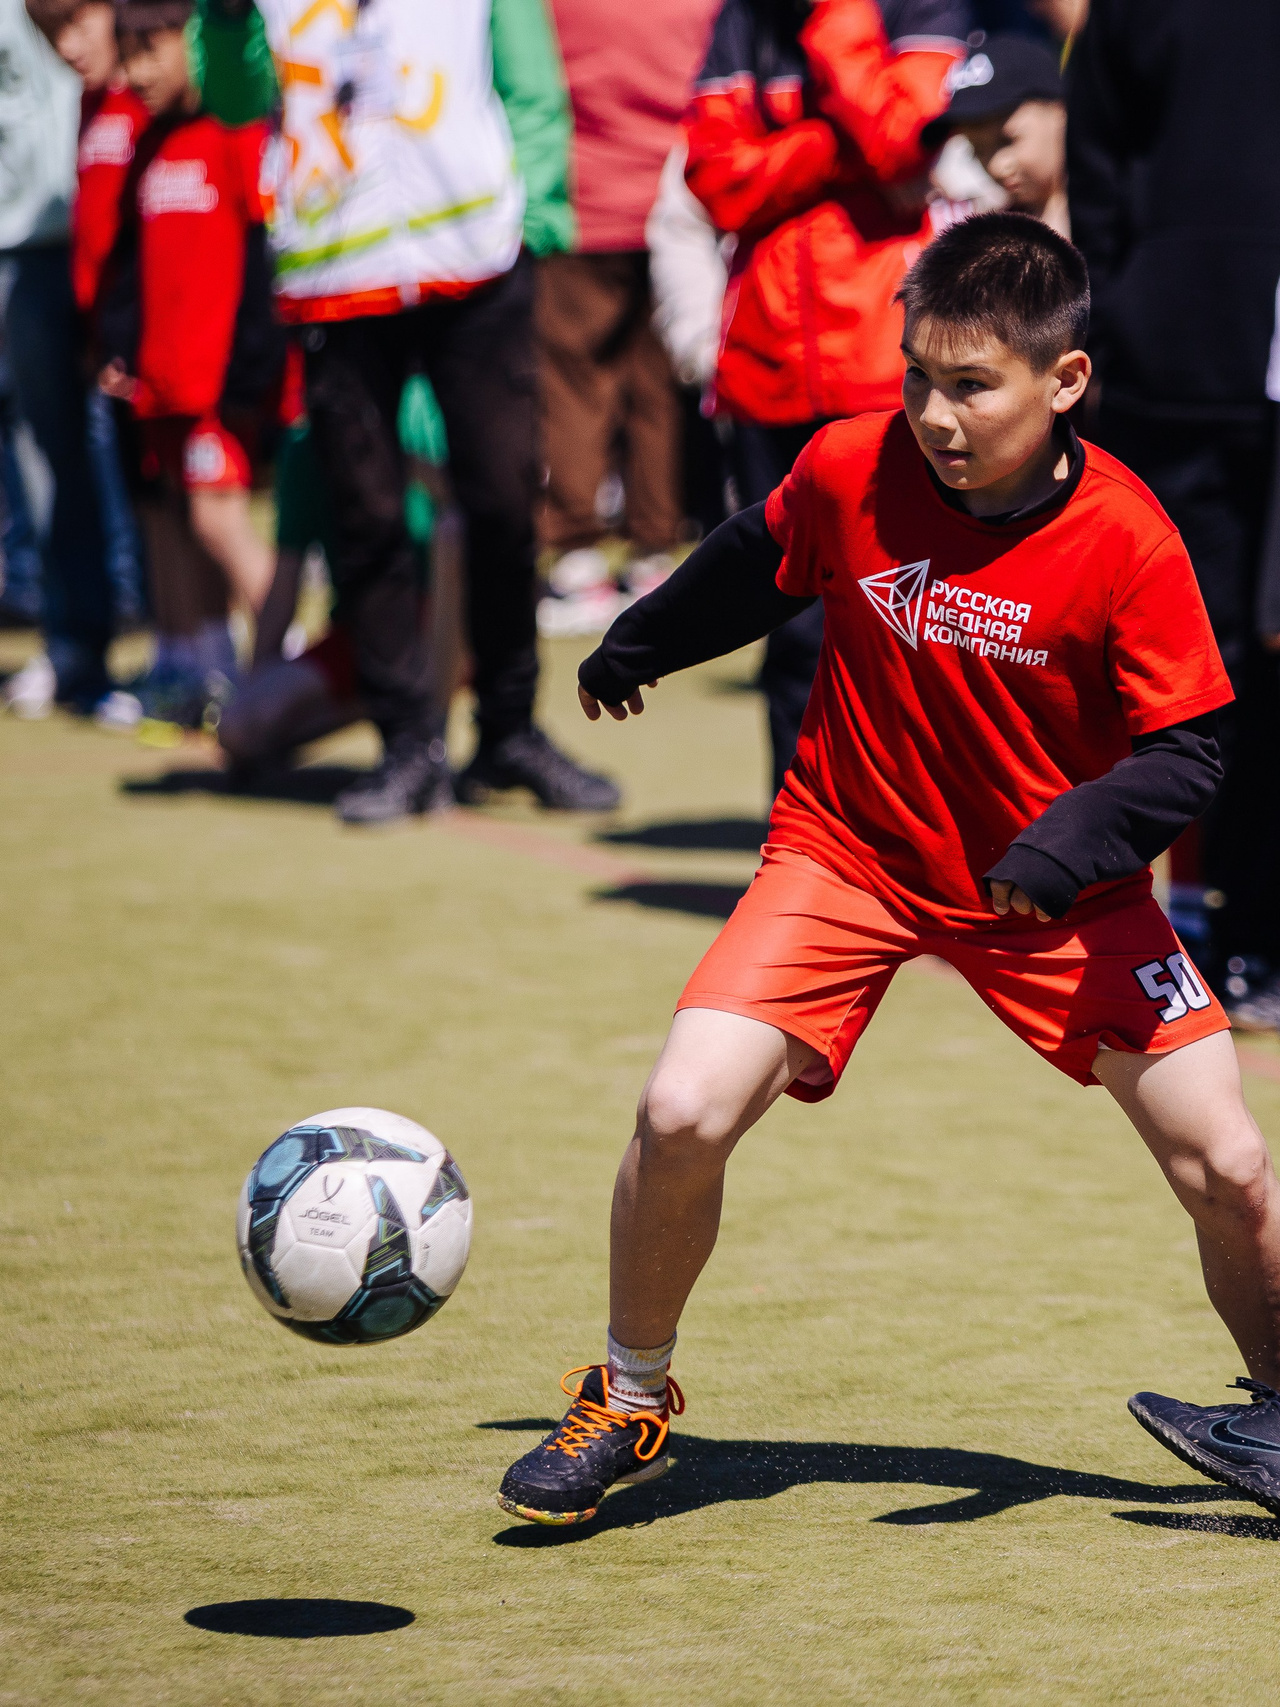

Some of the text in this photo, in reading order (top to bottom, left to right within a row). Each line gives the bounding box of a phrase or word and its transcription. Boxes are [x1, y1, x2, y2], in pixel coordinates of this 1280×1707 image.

[926, 601, 1022, 643] МЕДНАЯ
[930, 579, 1032, 623] РУССКАЯ
[923, 622, 1049, 666] КОМПАНИЯ
[1131, 950, 1212, 1025] 50
[298, 1206, 351, 1226] JÖGEL
[310, 1227, 334, 1239] TEAM
